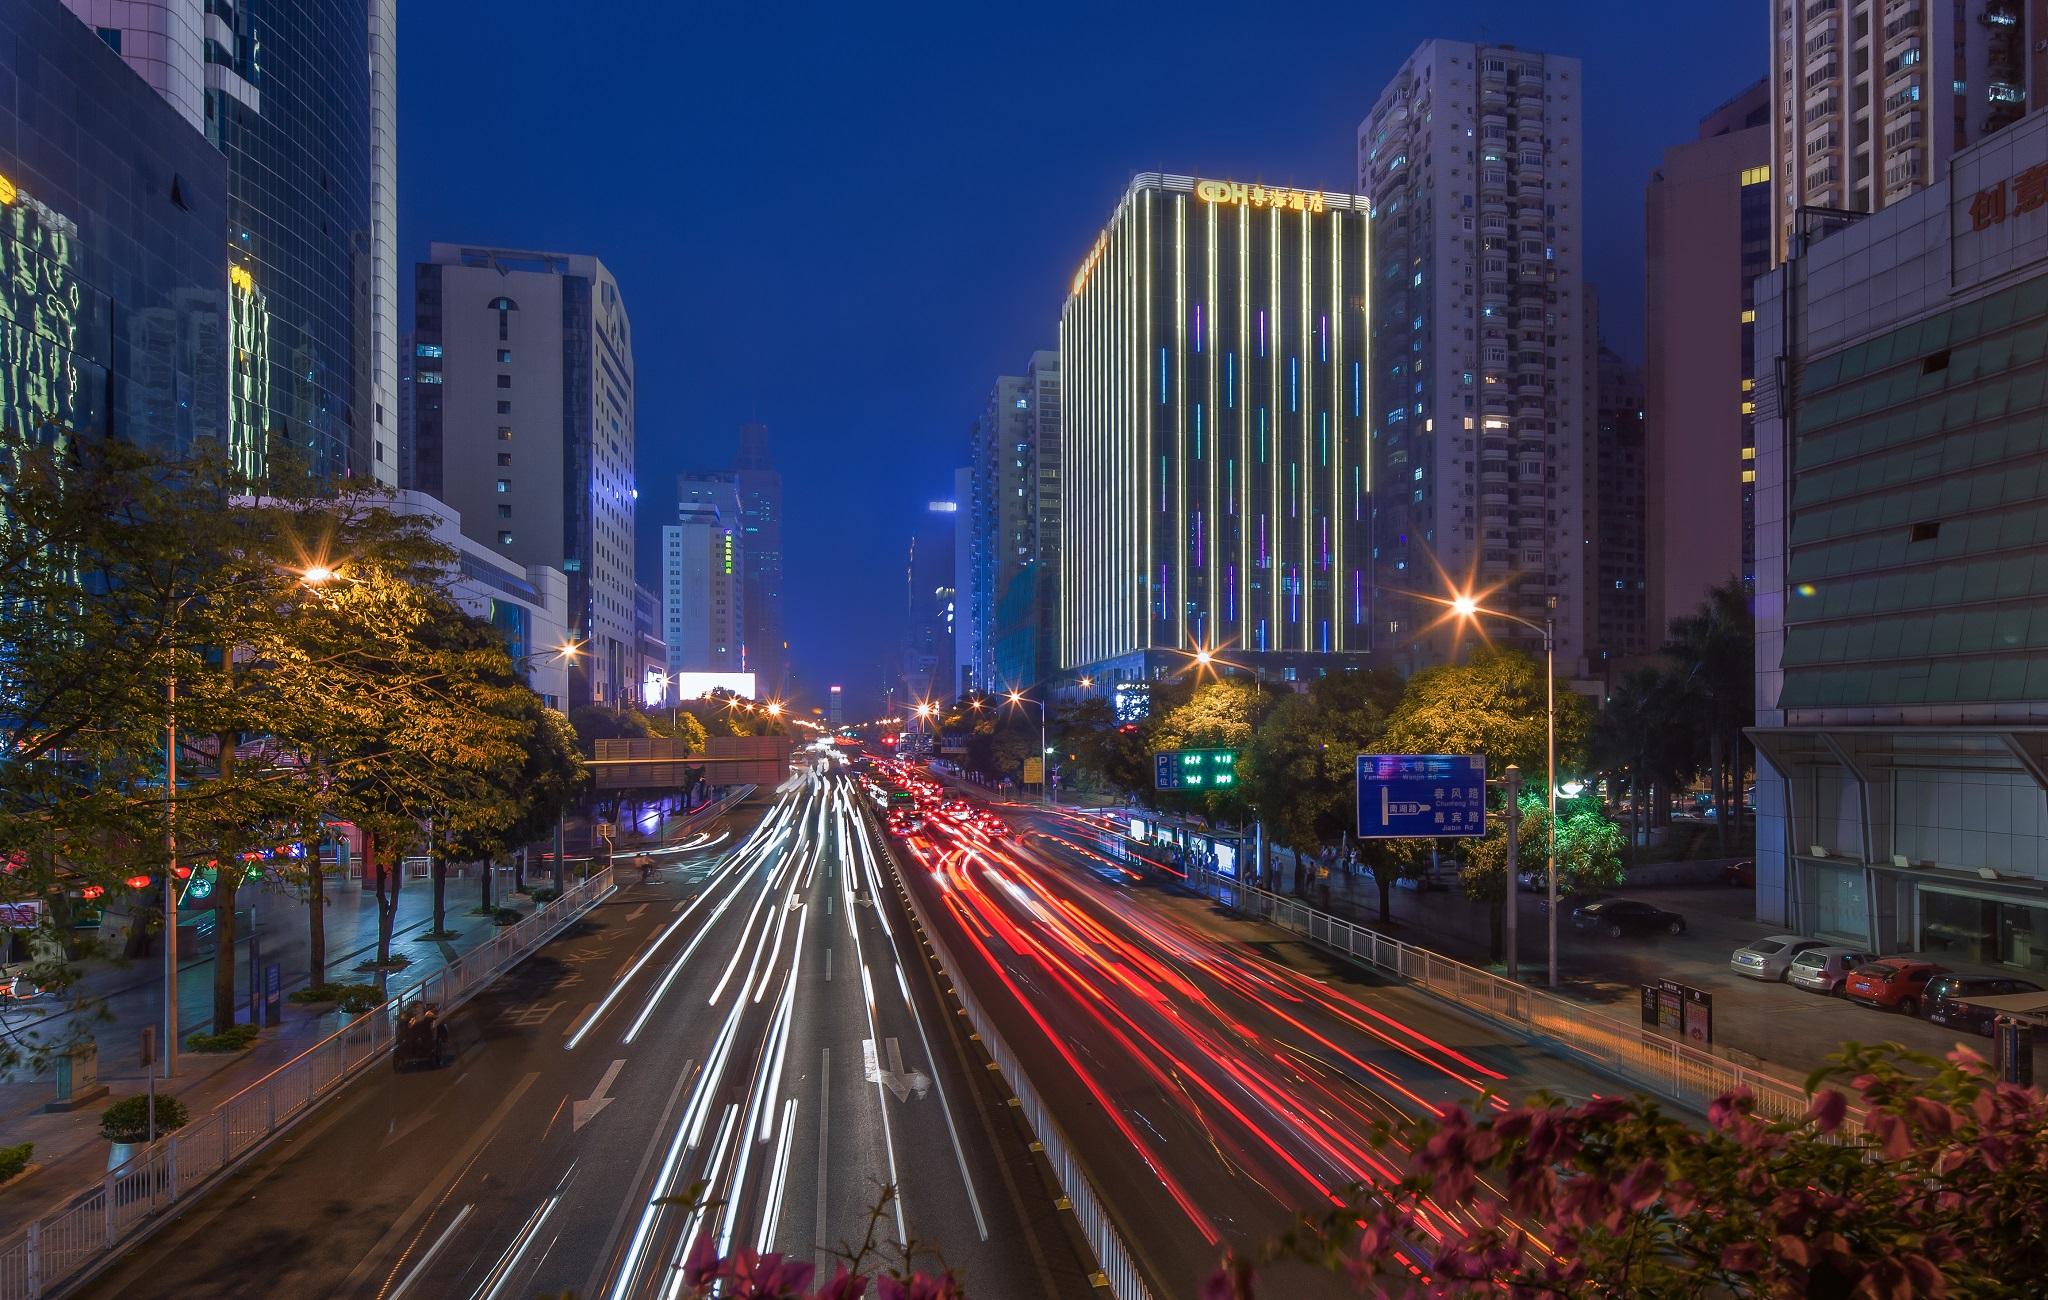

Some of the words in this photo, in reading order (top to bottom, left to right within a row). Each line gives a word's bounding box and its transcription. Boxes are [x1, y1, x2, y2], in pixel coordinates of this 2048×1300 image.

[1197, 180, 1248, 205] GDH
[1159, 756, 1168, 766] P
[1434, 788, 1479, 799] 春风路
